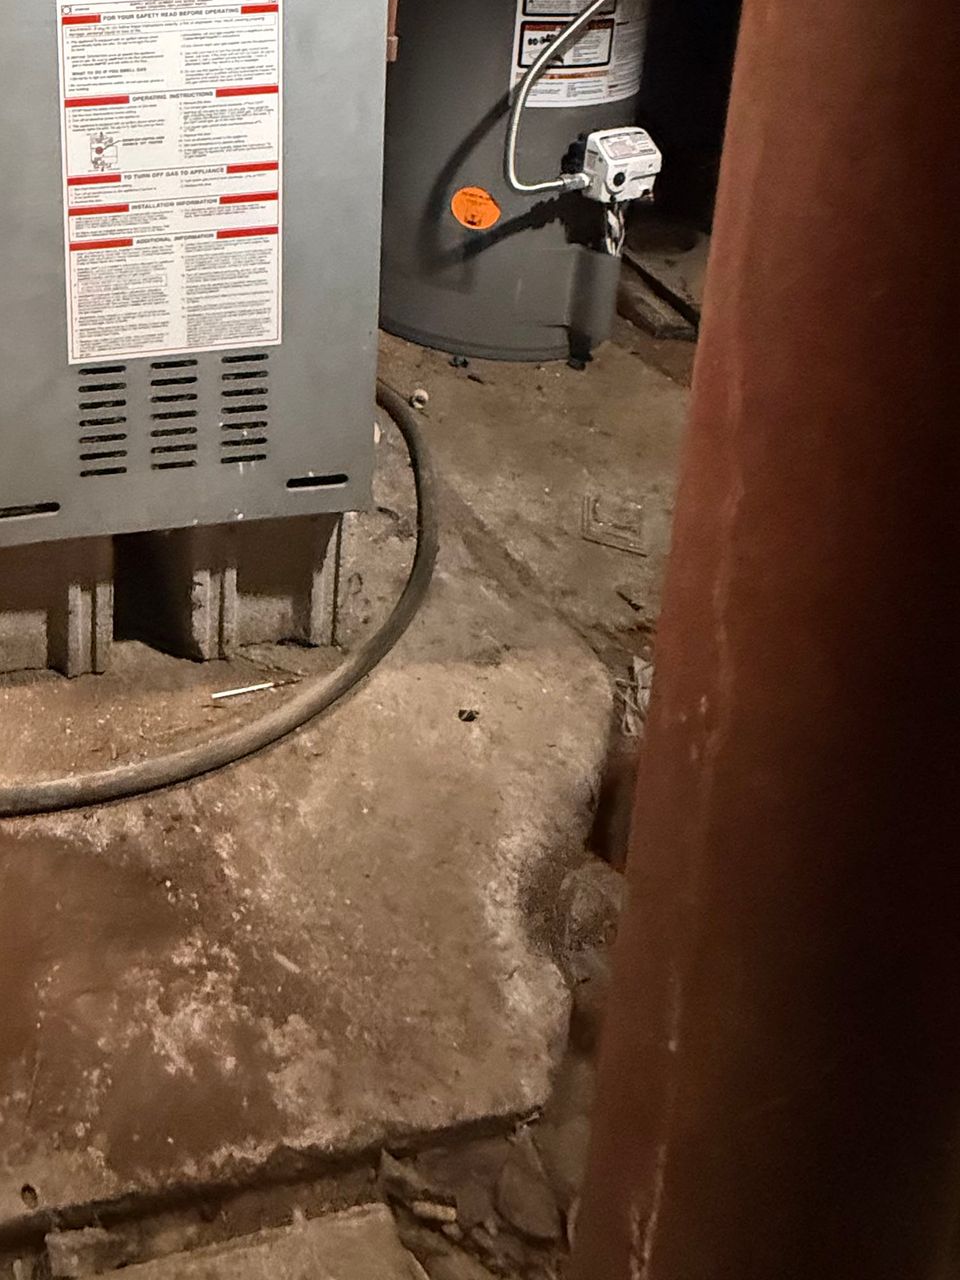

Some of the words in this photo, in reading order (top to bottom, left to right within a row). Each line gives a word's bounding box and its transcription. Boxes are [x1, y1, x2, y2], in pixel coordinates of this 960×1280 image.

[117, 13, 135, 21] YOUR
[136, 12, 159, 20] SAFETY
[178, 9, 204, 17] BEFORE
[204, 7, 240, 15] OPERATING
[169, 90, 214, 99] INSTRUCTIONS
[133, 172, 151, 180] TURN
[152, 171, 164, 179] OFF
[190, 166, 225, 175] APPLIANCE
